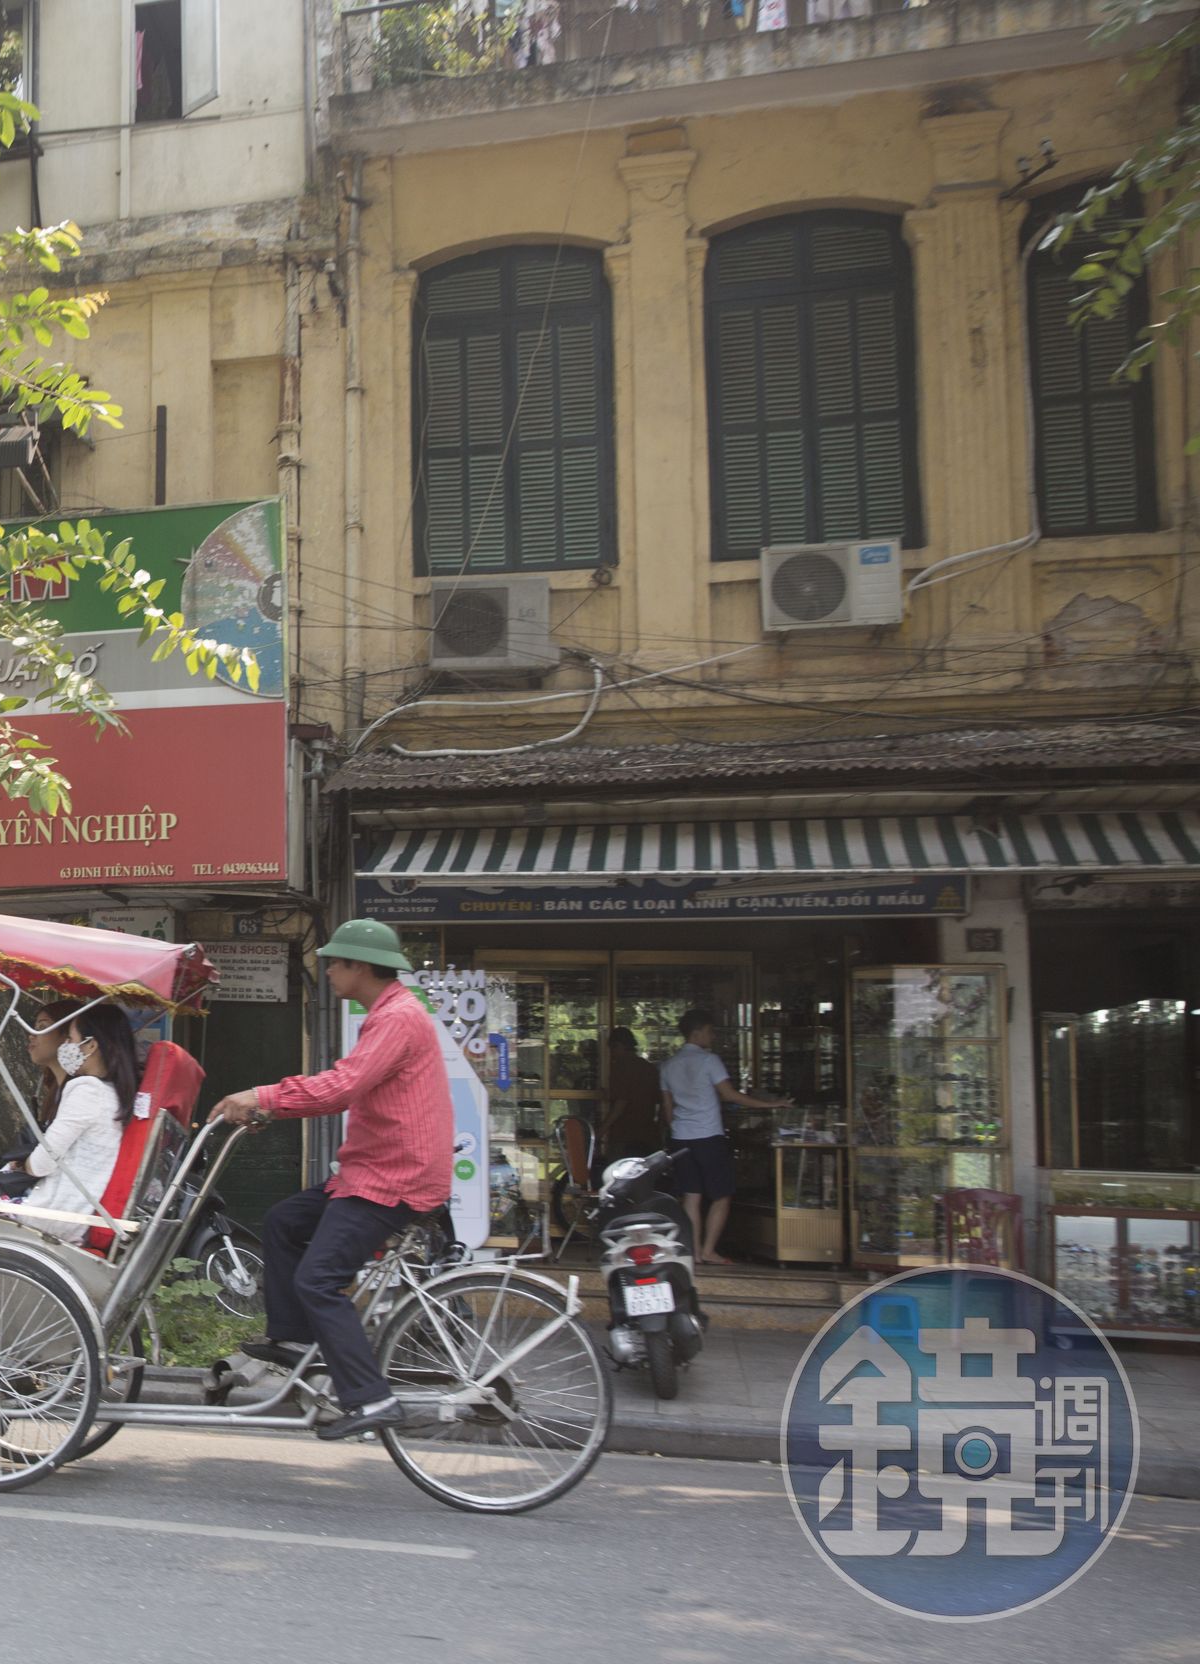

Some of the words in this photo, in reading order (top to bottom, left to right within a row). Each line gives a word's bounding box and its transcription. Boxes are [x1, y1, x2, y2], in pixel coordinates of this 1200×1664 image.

[57, 804, 179, 846] NGHIỆP
[191, 863, 215, 875] TEL
[239, 944, 279, 956] SHOES
[414, 963, 485, 989] GIẢM
